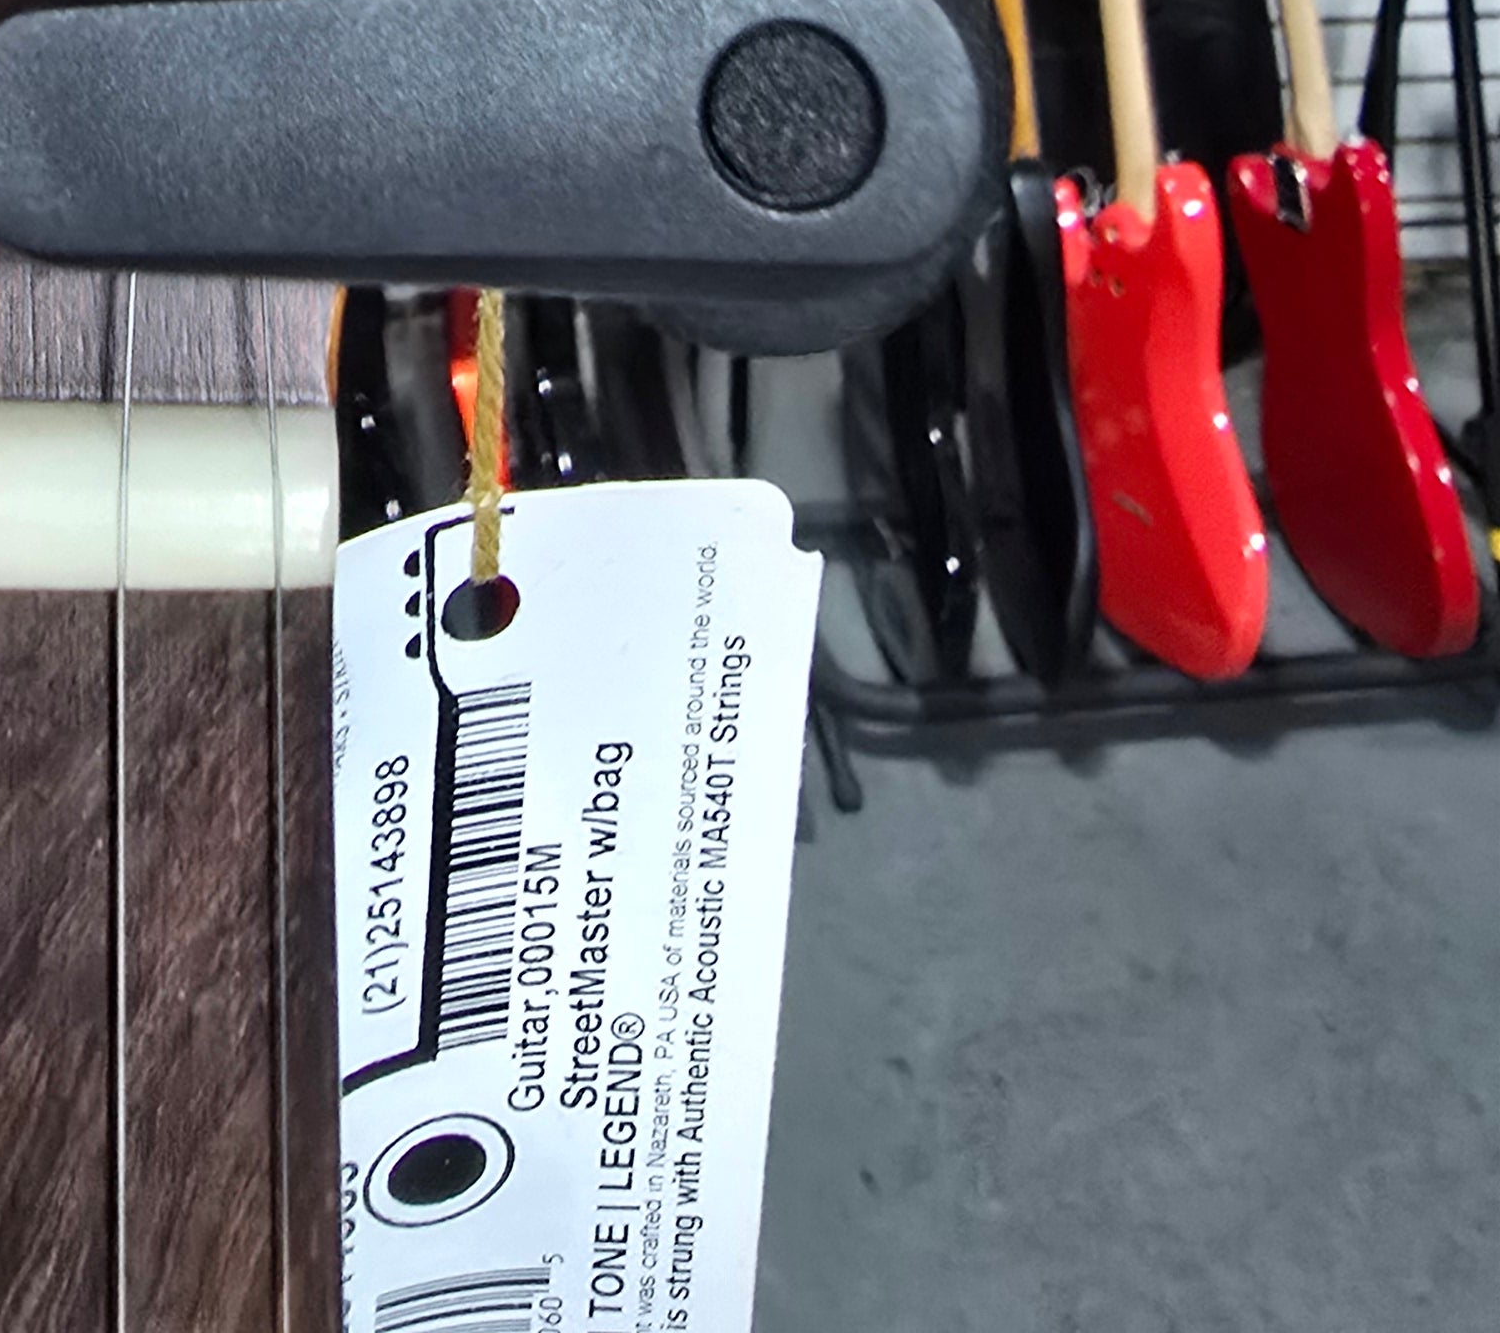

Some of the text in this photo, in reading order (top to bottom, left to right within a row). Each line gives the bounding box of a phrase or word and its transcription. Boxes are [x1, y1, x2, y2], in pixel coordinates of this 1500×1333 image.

[690, 614, 711, 649] the
[685, 657, 706, 735] around
[709, 635, 751, 743] Strings
[677, 743, 700, 833] sourced
[698, 754, 736, 868] MA540T
[362, 755, 409, 1014] (21)25143898
[560, 742, 633, 1109] StreetMaster w/bag
[668, 838, 692, 937] materials
[663, 944, 683, 965] of
[688, 879, 725, 1004] Acoustic
[659, 972, 681, 1021] USA
[654, 1028, 676, 1060] PA
[677, 1012, 714, 1142] Authentic
[672, 1150, 702, 1205] with
[588, 1223, 629, 1318] TONE
[639, 1199, 662, 1270] crafted
[666, 1215, 703, 1301] strung
